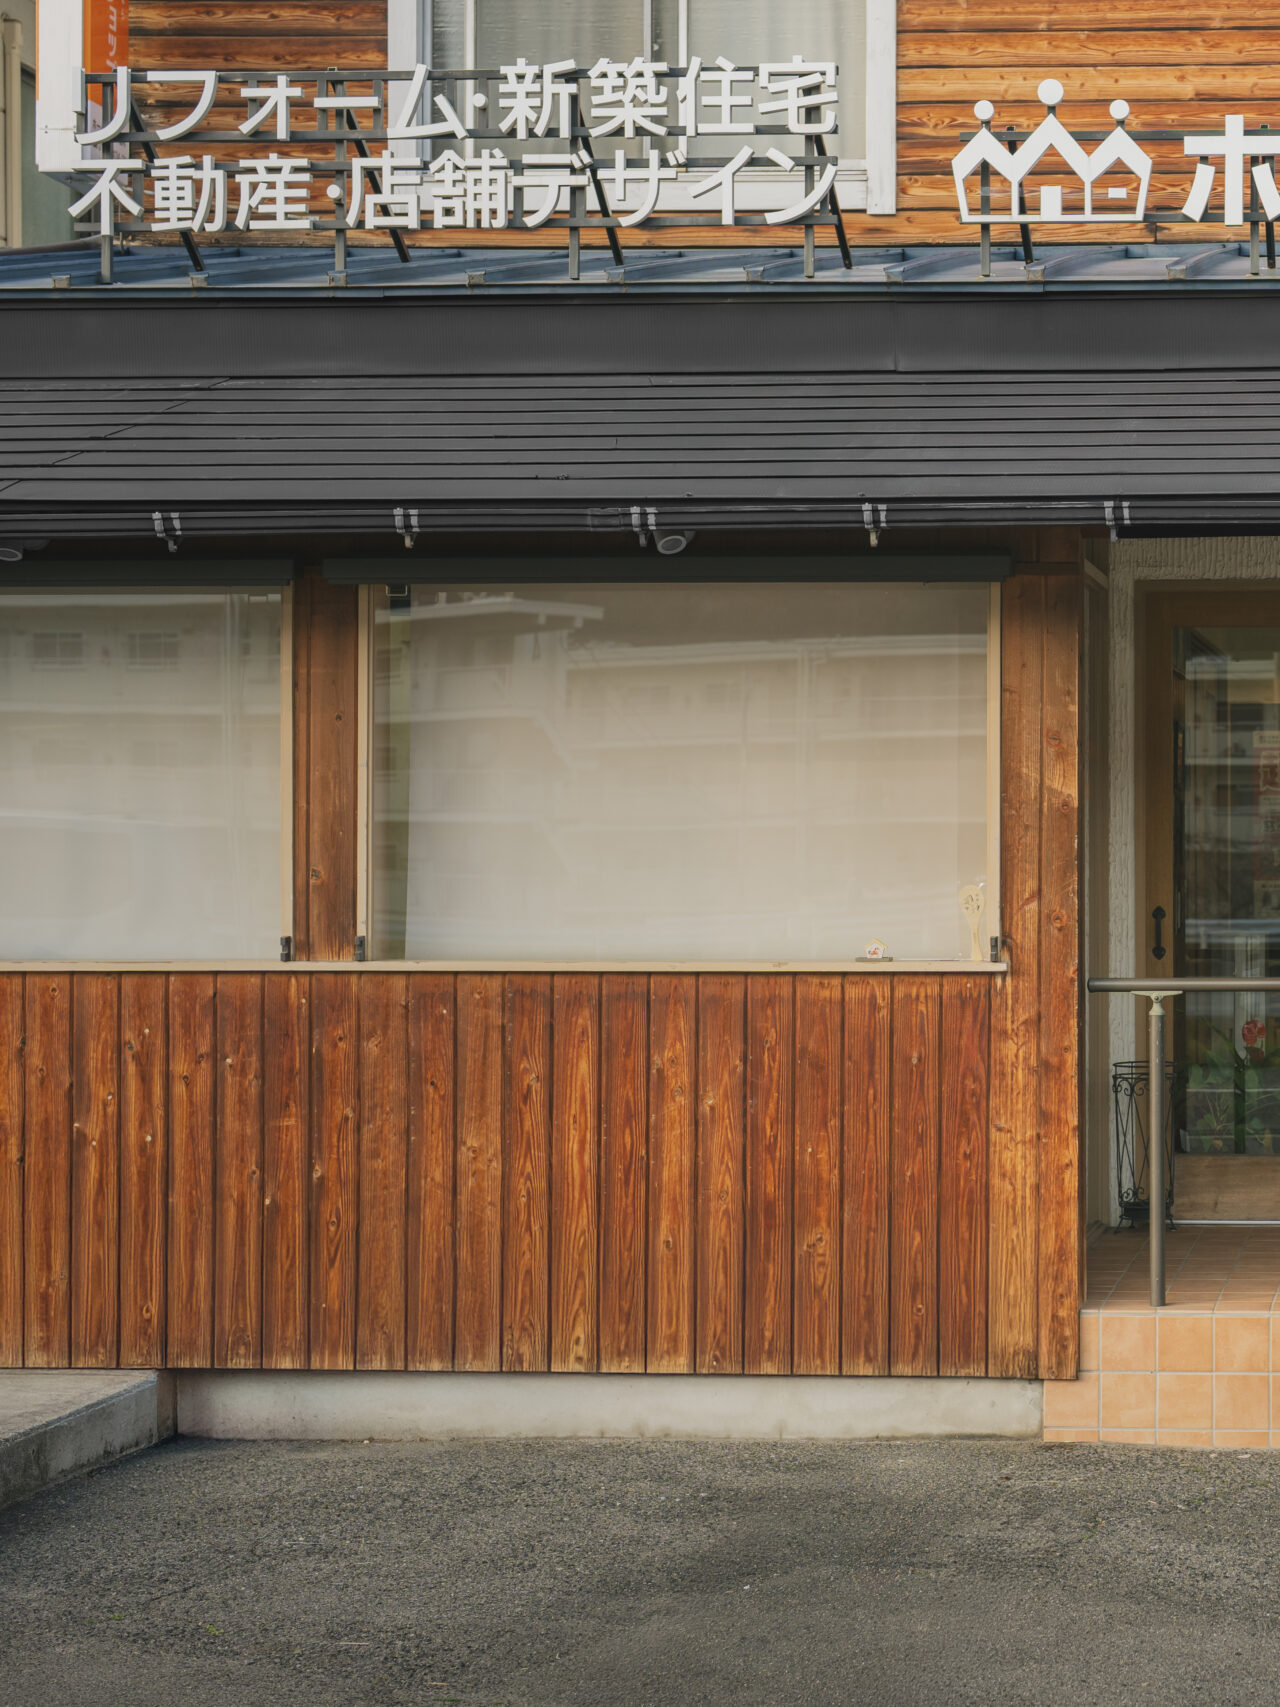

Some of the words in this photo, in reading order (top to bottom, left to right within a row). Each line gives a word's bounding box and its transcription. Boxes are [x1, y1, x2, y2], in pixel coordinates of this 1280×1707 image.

[72, 55, 839, 145] リフォーム・新築住宅
[68, 146, 838, 235] 不動産・店舗デザイン
